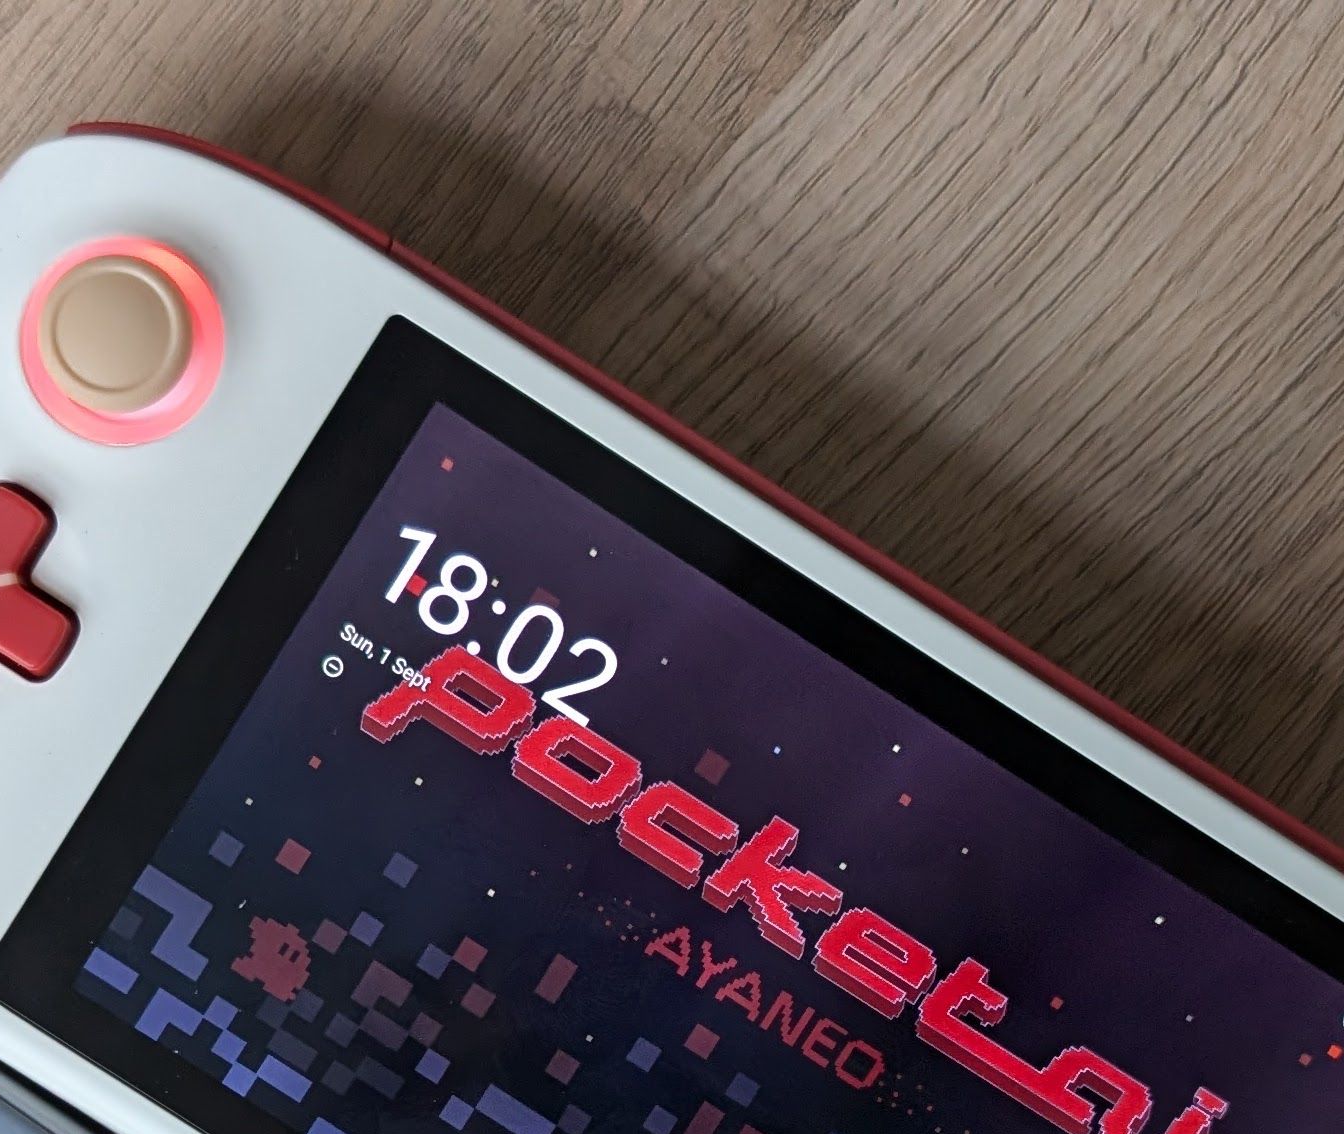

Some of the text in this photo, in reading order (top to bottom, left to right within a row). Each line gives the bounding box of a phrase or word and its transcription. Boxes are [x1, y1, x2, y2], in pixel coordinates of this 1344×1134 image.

[339, 623, 432, 693] Sun, 1 Sept
[384, 526, 619, 727] 18:02
[644, 924, 886, 1092] AYANEO
